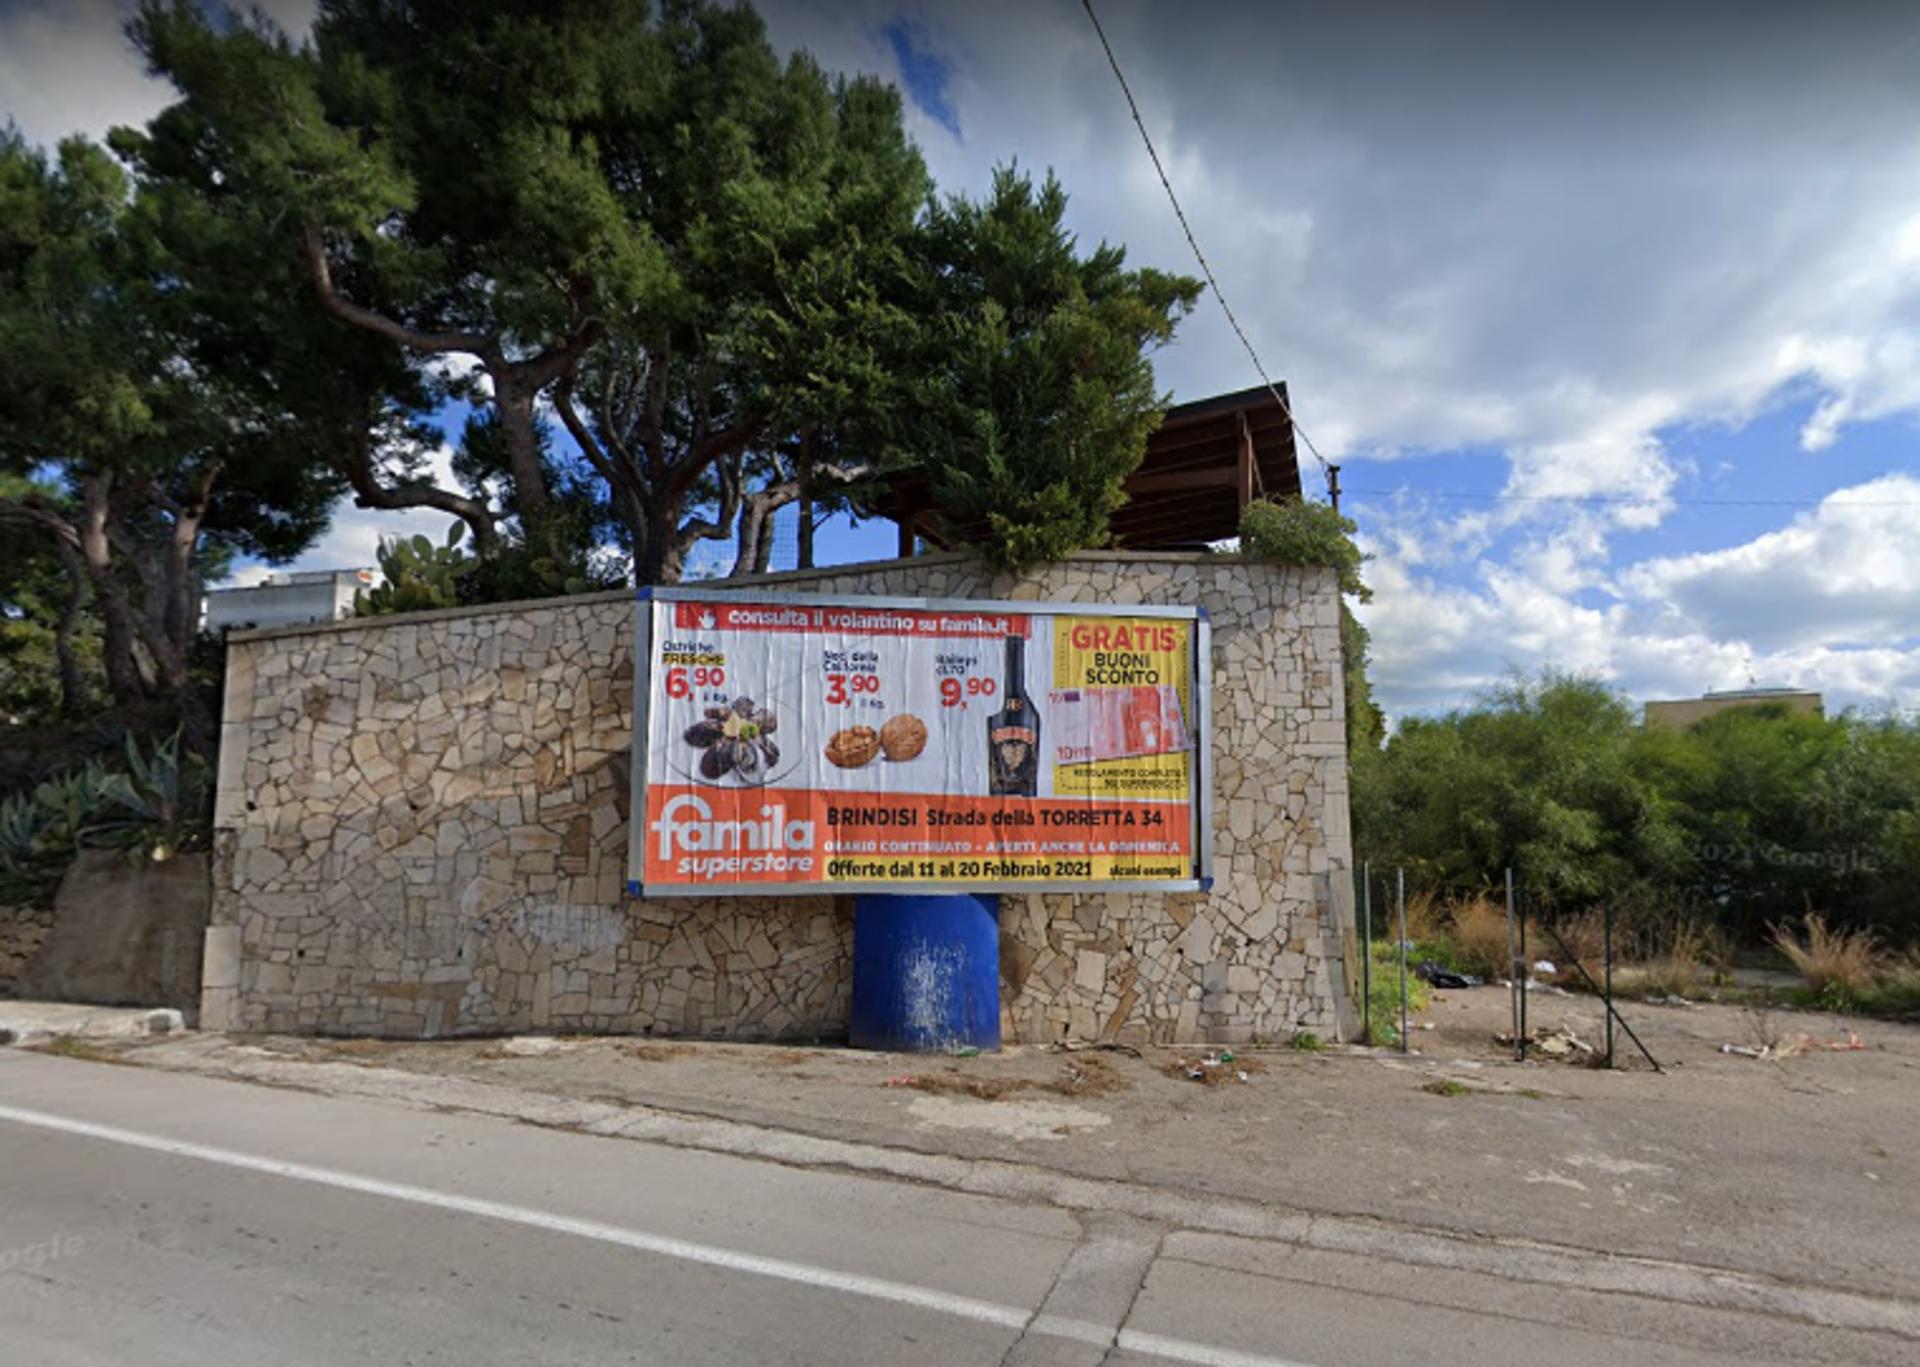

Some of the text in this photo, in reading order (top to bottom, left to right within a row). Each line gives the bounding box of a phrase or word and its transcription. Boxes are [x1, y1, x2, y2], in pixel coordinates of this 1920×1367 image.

[728, 610, 808, 625] consulta
[814, 610, 824, 627] il
[829, 612, 914, 630] volantino
[918, 618, 936, 632] su
[1071, 623, 1177, 653] GRATIS
[1094, 652, 1150, 668] BUONI
[1086, 669, 1160, 685] SCONTO
[650, 793, 815, 861] famila
[827, 806, 1163, 827] BRINDISI Strada della TORRETTA 34
[1088, 841, 1105, 853] LA
[677, 851, 813, 880] superstore
[828, 860, 1092, 878] Offerte dal 11 al 20 Febbraio 2021
